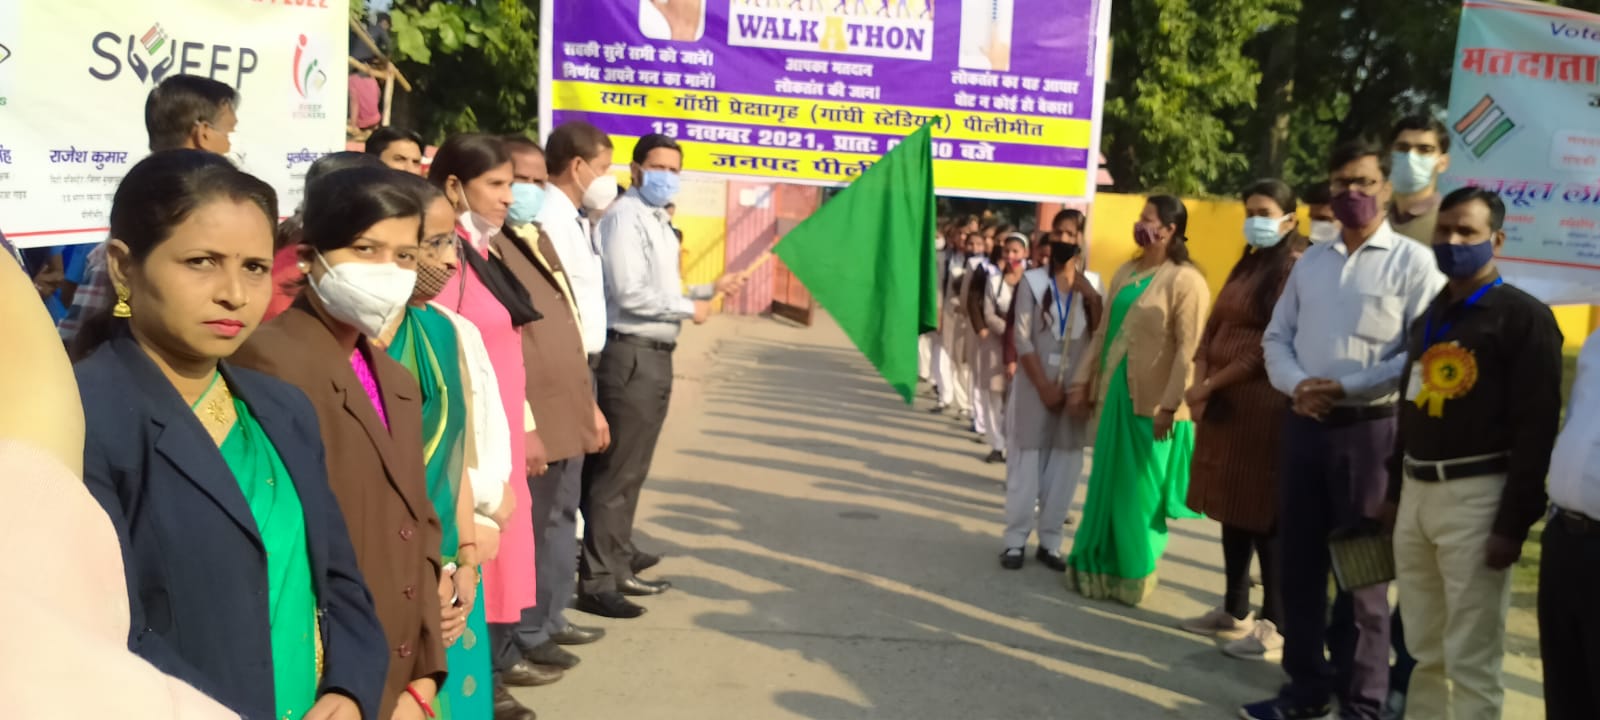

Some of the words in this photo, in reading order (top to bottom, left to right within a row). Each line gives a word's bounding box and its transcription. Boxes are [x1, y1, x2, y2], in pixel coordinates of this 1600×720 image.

[785, 57, 828, 74] आपका
[1461, 48, 1599, 84] मतदाता
[600, 91, 647, 107] स्थान
[651, 121, 678, 138] 13
[685, 123, 752, 144] नवम्बर
[758, 130, 825, 151] 2021,
[960, 142, 996, 161] बजे
[49, 145, 88, 164] राजेश
[91, 150, 128, 170] कुमार
[709, 153, 800, 172] जनपद
